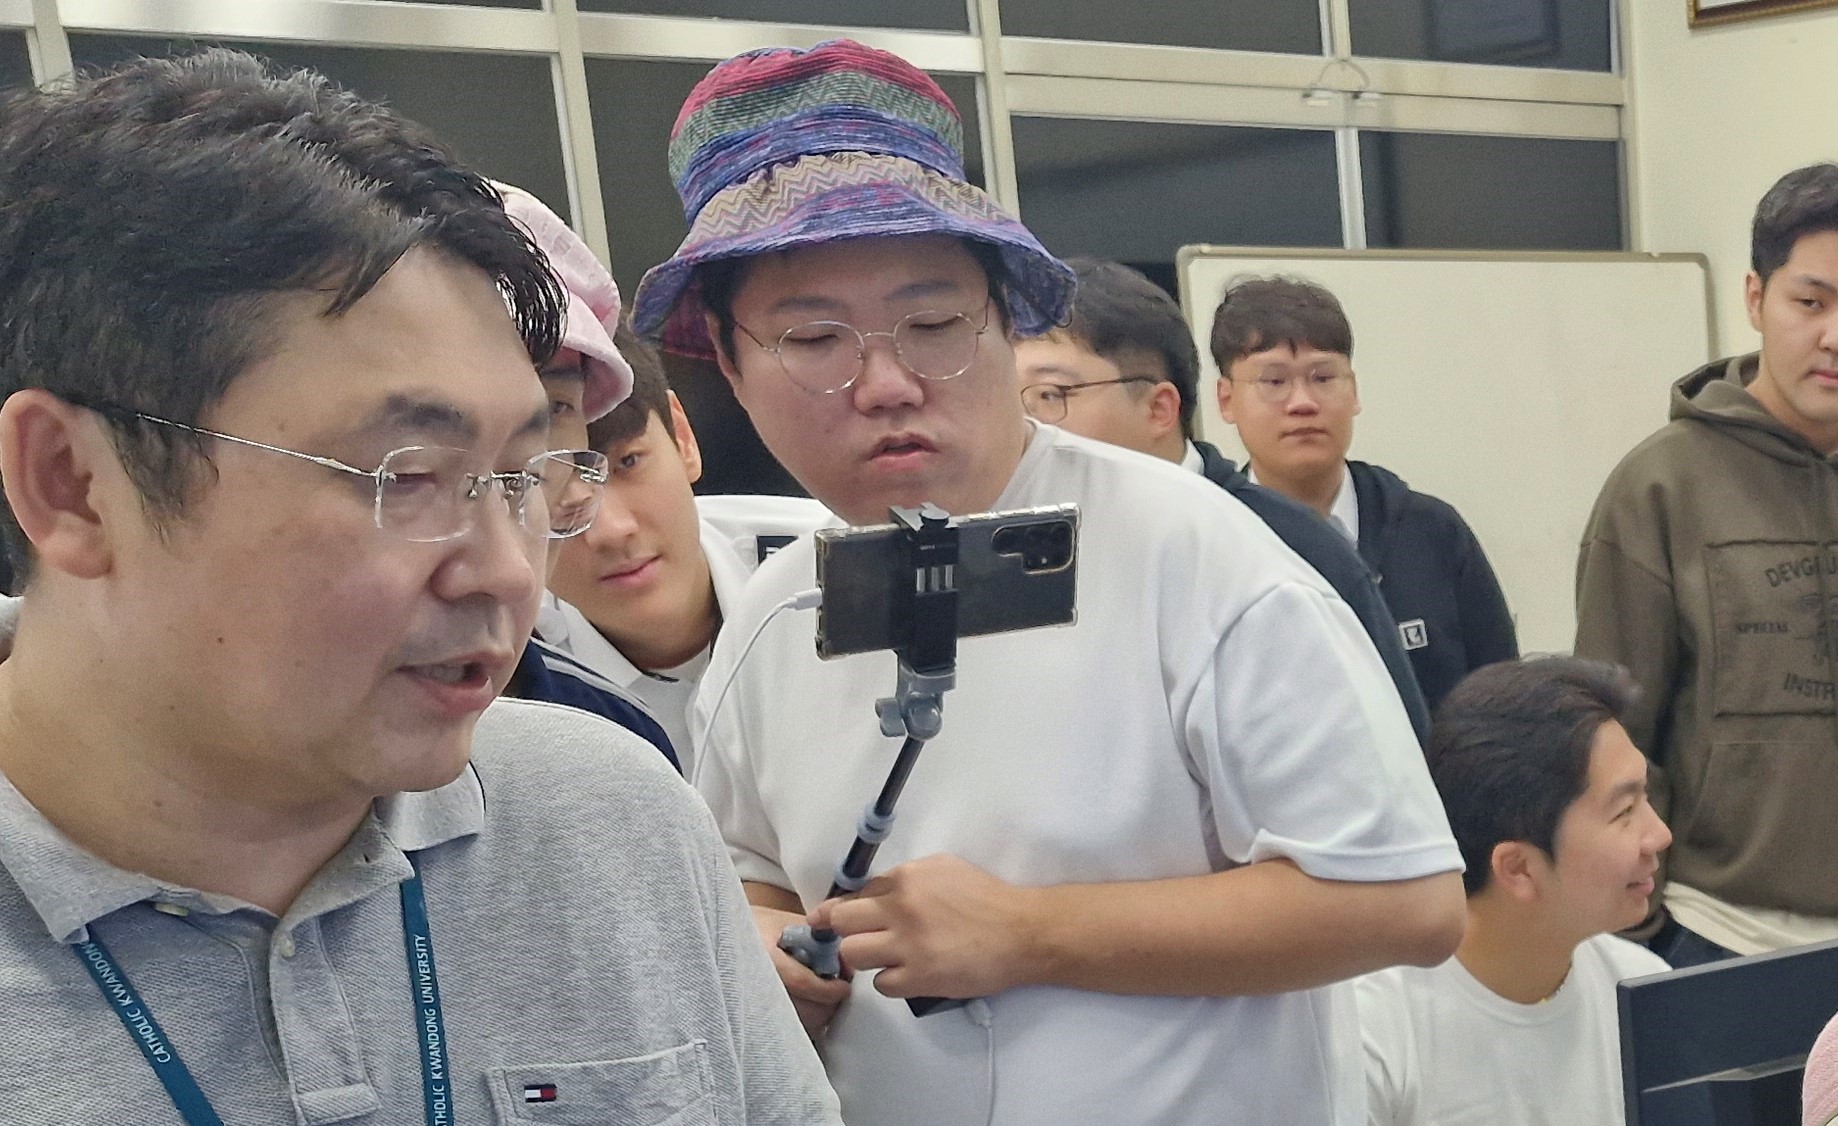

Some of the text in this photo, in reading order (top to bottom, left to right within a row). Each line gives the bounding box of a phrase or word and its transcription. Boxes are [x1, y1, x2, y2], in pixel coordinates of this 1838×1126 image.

[81, 942, 171, 1063] CATHOLIC KWANDON
[414, 934, 435, 1004] UNIVERSITY
[423, 1008, 444, 1081] KWANDONG
